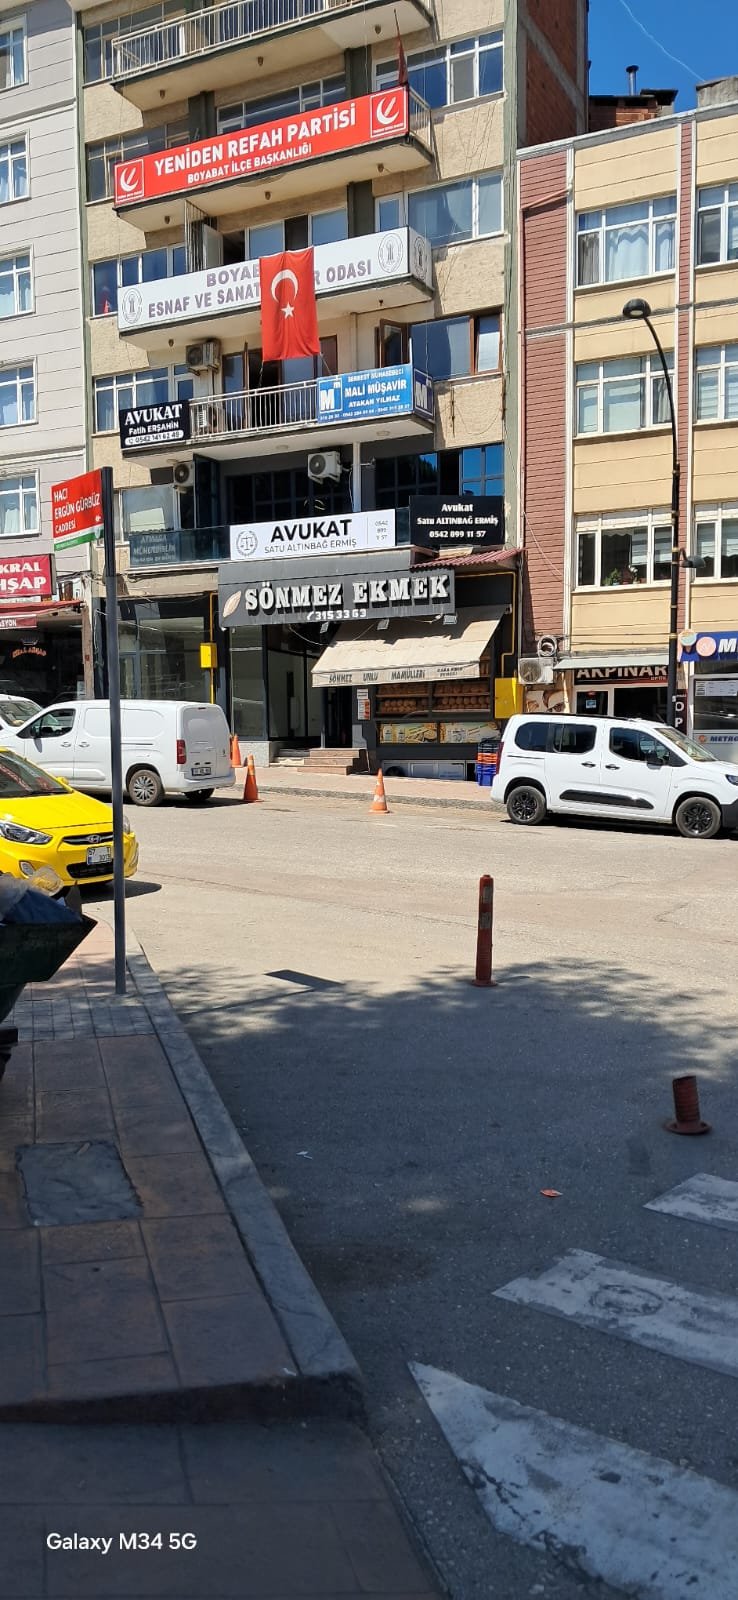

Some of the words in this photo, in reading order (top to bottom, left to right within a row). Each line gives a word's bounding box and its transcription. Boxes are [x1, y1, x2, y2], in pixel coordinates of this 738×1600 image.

[154, 143, 223, 177] YENİDEN
[227, 126, 283, 158] REFAH
[286, 102, 356, 143] PARTİSİ
[187, 164, 230, 185] BOYABAT
[231, 158, 252, 174] İLÇE
[253, 142, 312, 168] BAŞKANLIĞI
[206, 263, 260, 288] BOYAB
[147, 296, 191, 319] ESNAF
[194, 291, 213, 309] VE
[326, 258, 373, 284] ODASI
[344, 385, 366, 398] MALİ
[367, 377, 407, 396] MÜŞAVİR
[348, 400, 375, 409] ATAKAN
[375, 394, 401, 404] YILMAZ
[124, 403, 183, 426] AVUKAT
[128, 427, 147, 436] Fatih
[147, 420, 179, 433] ERŞAHİN
[54, 501, 76, 520] ERGÜN
[75, 492, 101, 513] GÜRBÜZ
[441, 503, 474, 512] Avukat
[55, 518, 77, 535] CADDESİ
[416, 517, 435, 526] Satu
[435, 514, 474, 526] ALTINBAĞ
[474, 513, 499, 527] ERMİŞ
[271, 518, 353, 543] AVUKAT
[429, 530, 449, 539] 0542
[466, 530, 474, 538] 11
[475, 530, 487, 538] 57
[264, 546, 286, 555] SATU
[286, 540, 329, 553] ALTINBAĞ
[329, 537, 358, 550] ERMİŞ
[0, 561, 42, 574] KRAL
[245, 582, 343, 611] SÖNMEZ
[353, 575, 448, 604] EKMEK
[315, 612, 334, 621] 315
[335, 611, 350, 619] 33
[329, 674, 353, 683] SÖNMEZ
